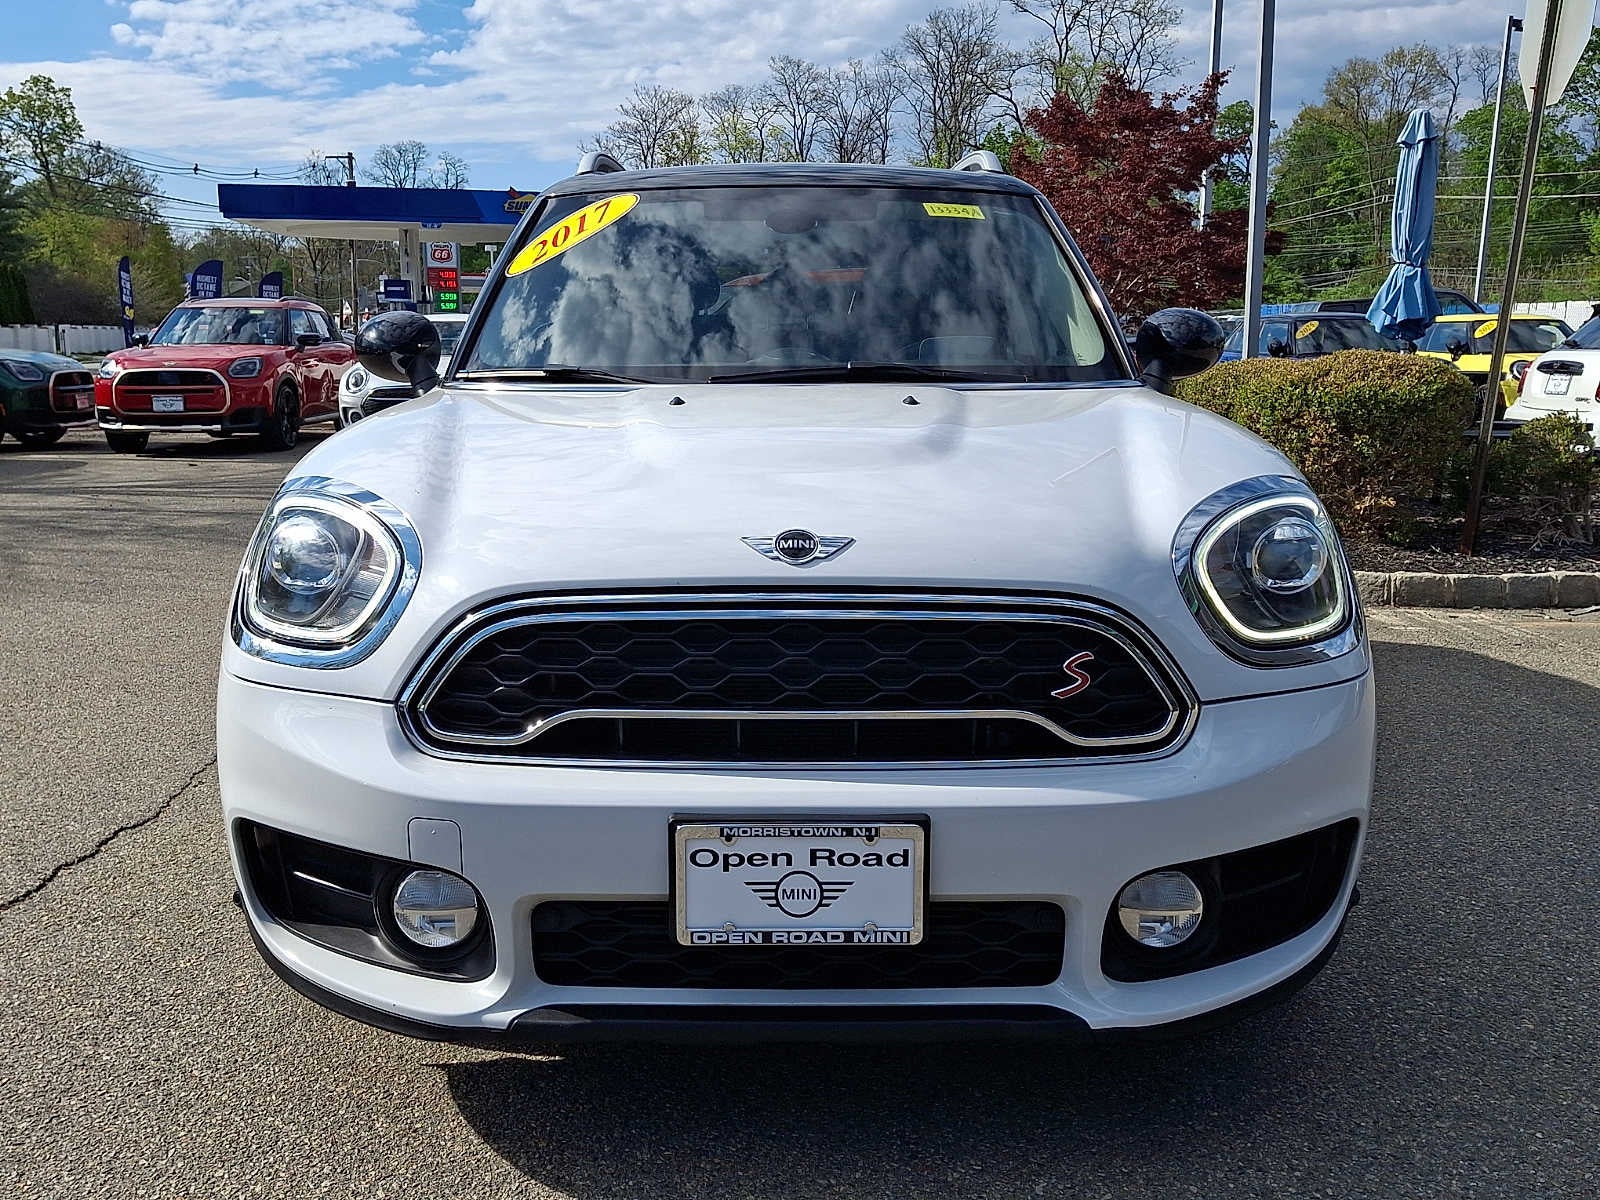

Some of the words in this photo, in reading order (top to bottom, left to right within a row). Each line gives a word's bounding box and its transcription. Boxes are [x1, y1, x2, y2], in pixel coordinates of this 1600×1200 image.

[532, 200, 612, 264] 2017
[434, 250, 449, 259] 66
[779, 539, 815, 549] MINI
[1051, 651, 1094, 699] S
[723, 827, 847, 837] MORRISTOWN,
[689, 848, 793, 872] Open
[809, 848, 910, 868] Road
[781, 888, 817, 900] MINI
[692, 932, 763, 944] OPEN
[771, 932, 845, 944] ROAD
[853, 932, 908, 944] MINI
